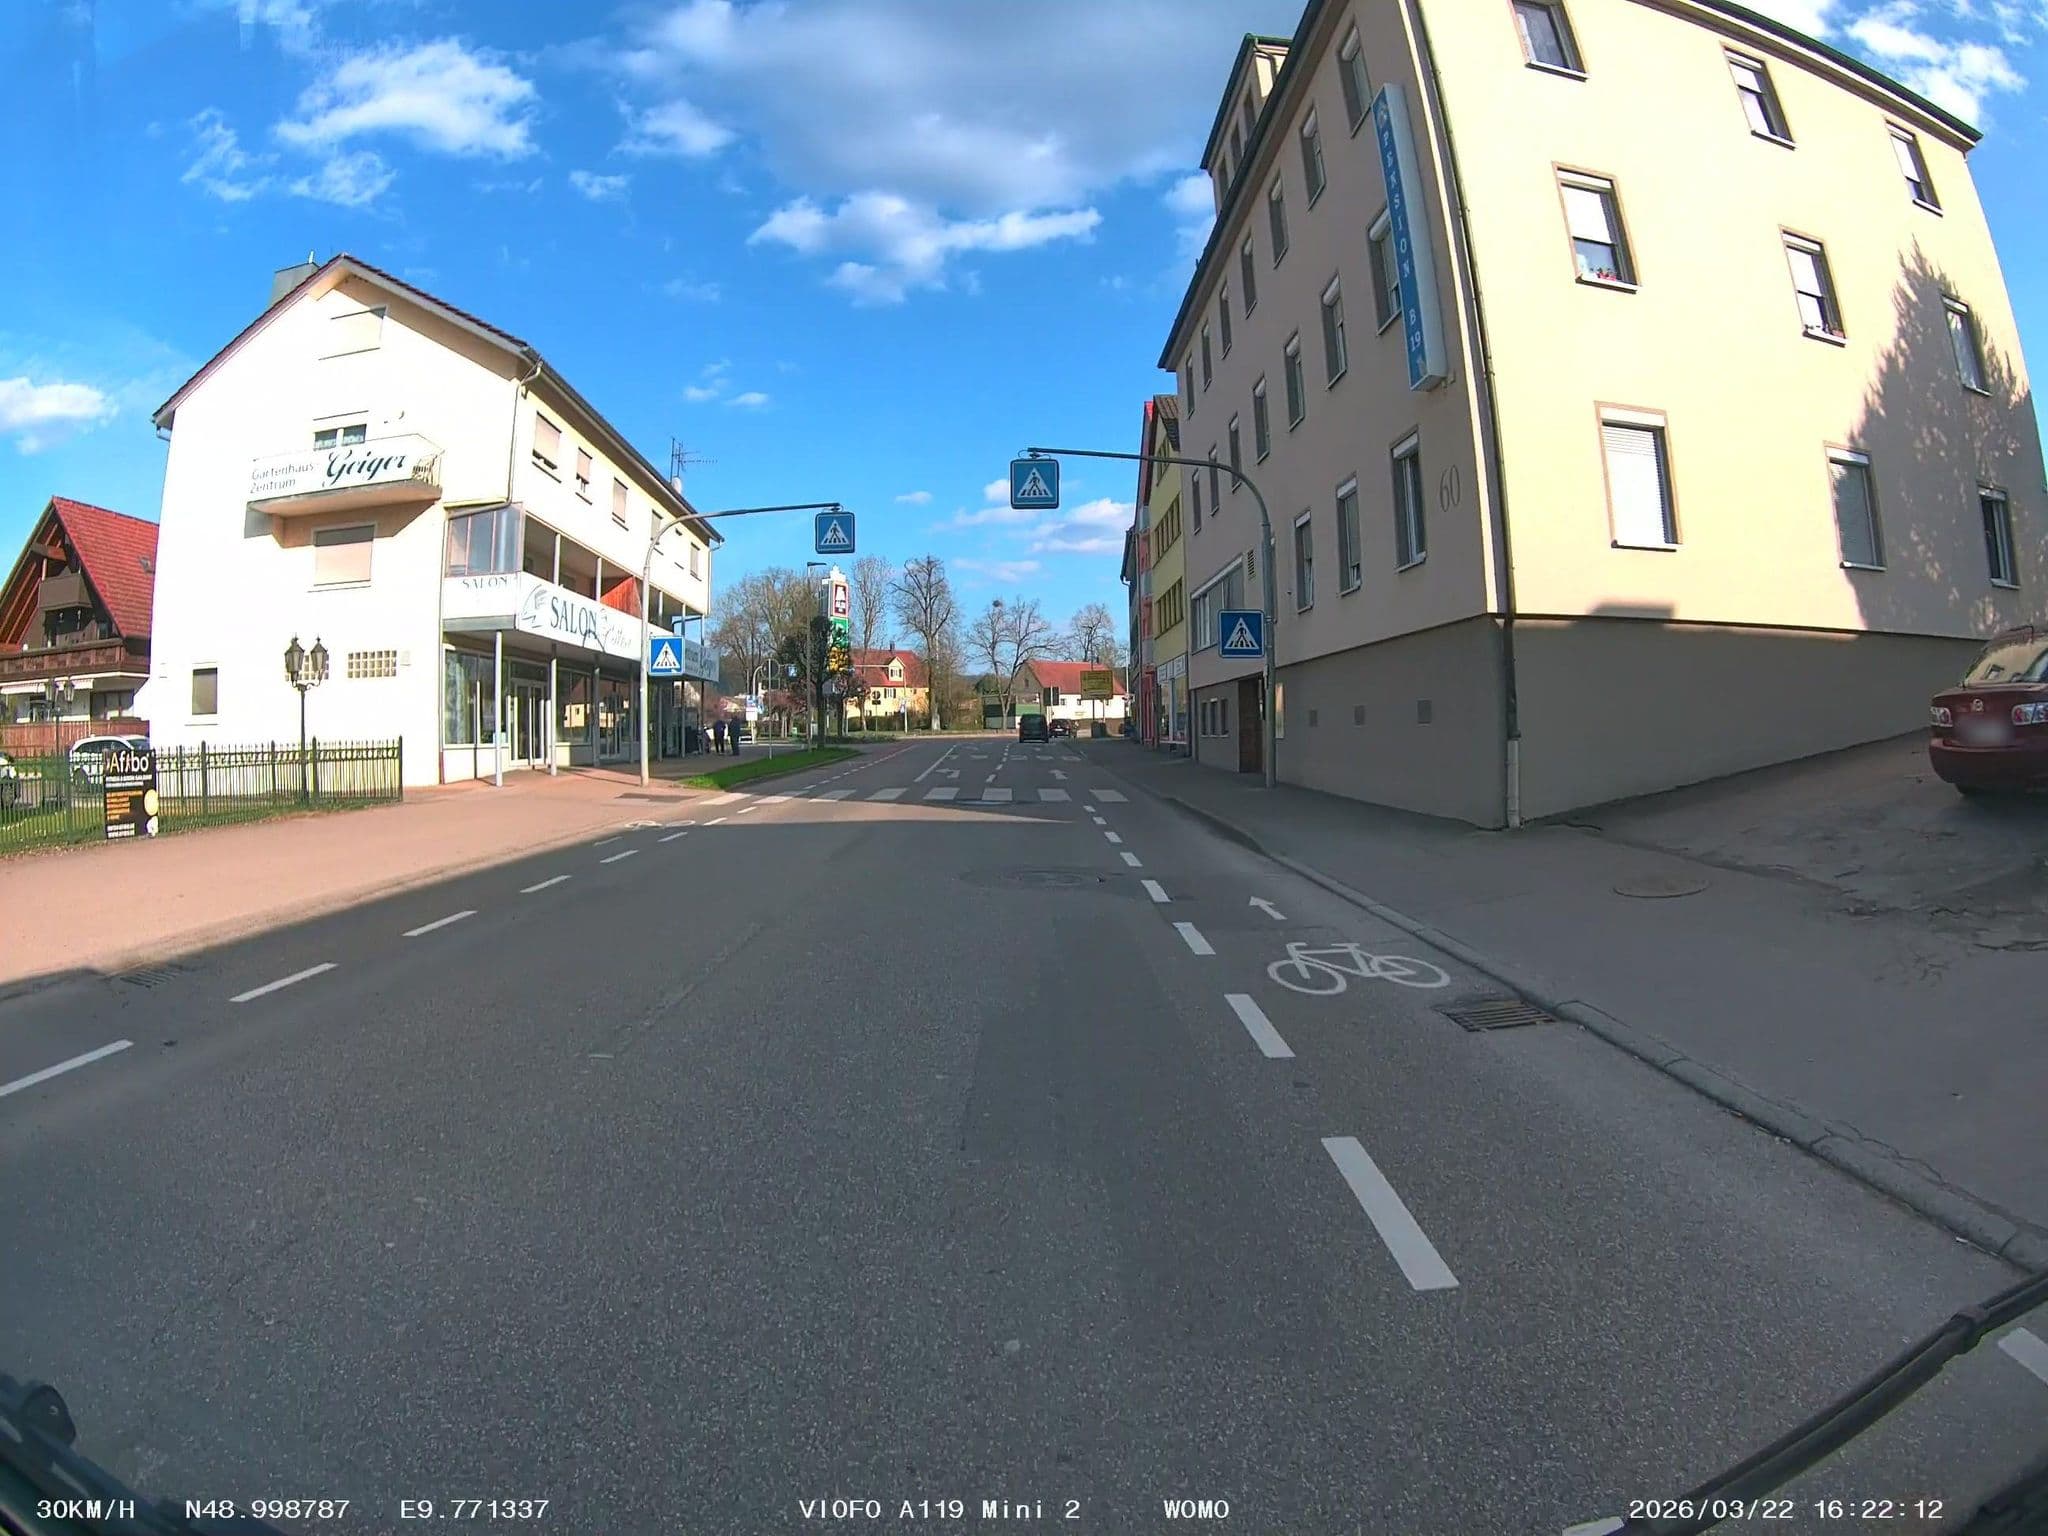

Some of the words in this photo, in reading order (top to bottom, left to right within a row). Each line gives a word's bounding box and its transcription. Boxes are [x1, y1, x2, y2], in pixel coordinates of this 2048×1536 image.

[250, 478, 296, 494] Zentrum
[322, 449, 406, 487] Geiger
[1440, 464, 1460, 512] 60
[550, 596, 598, 640] SALON
